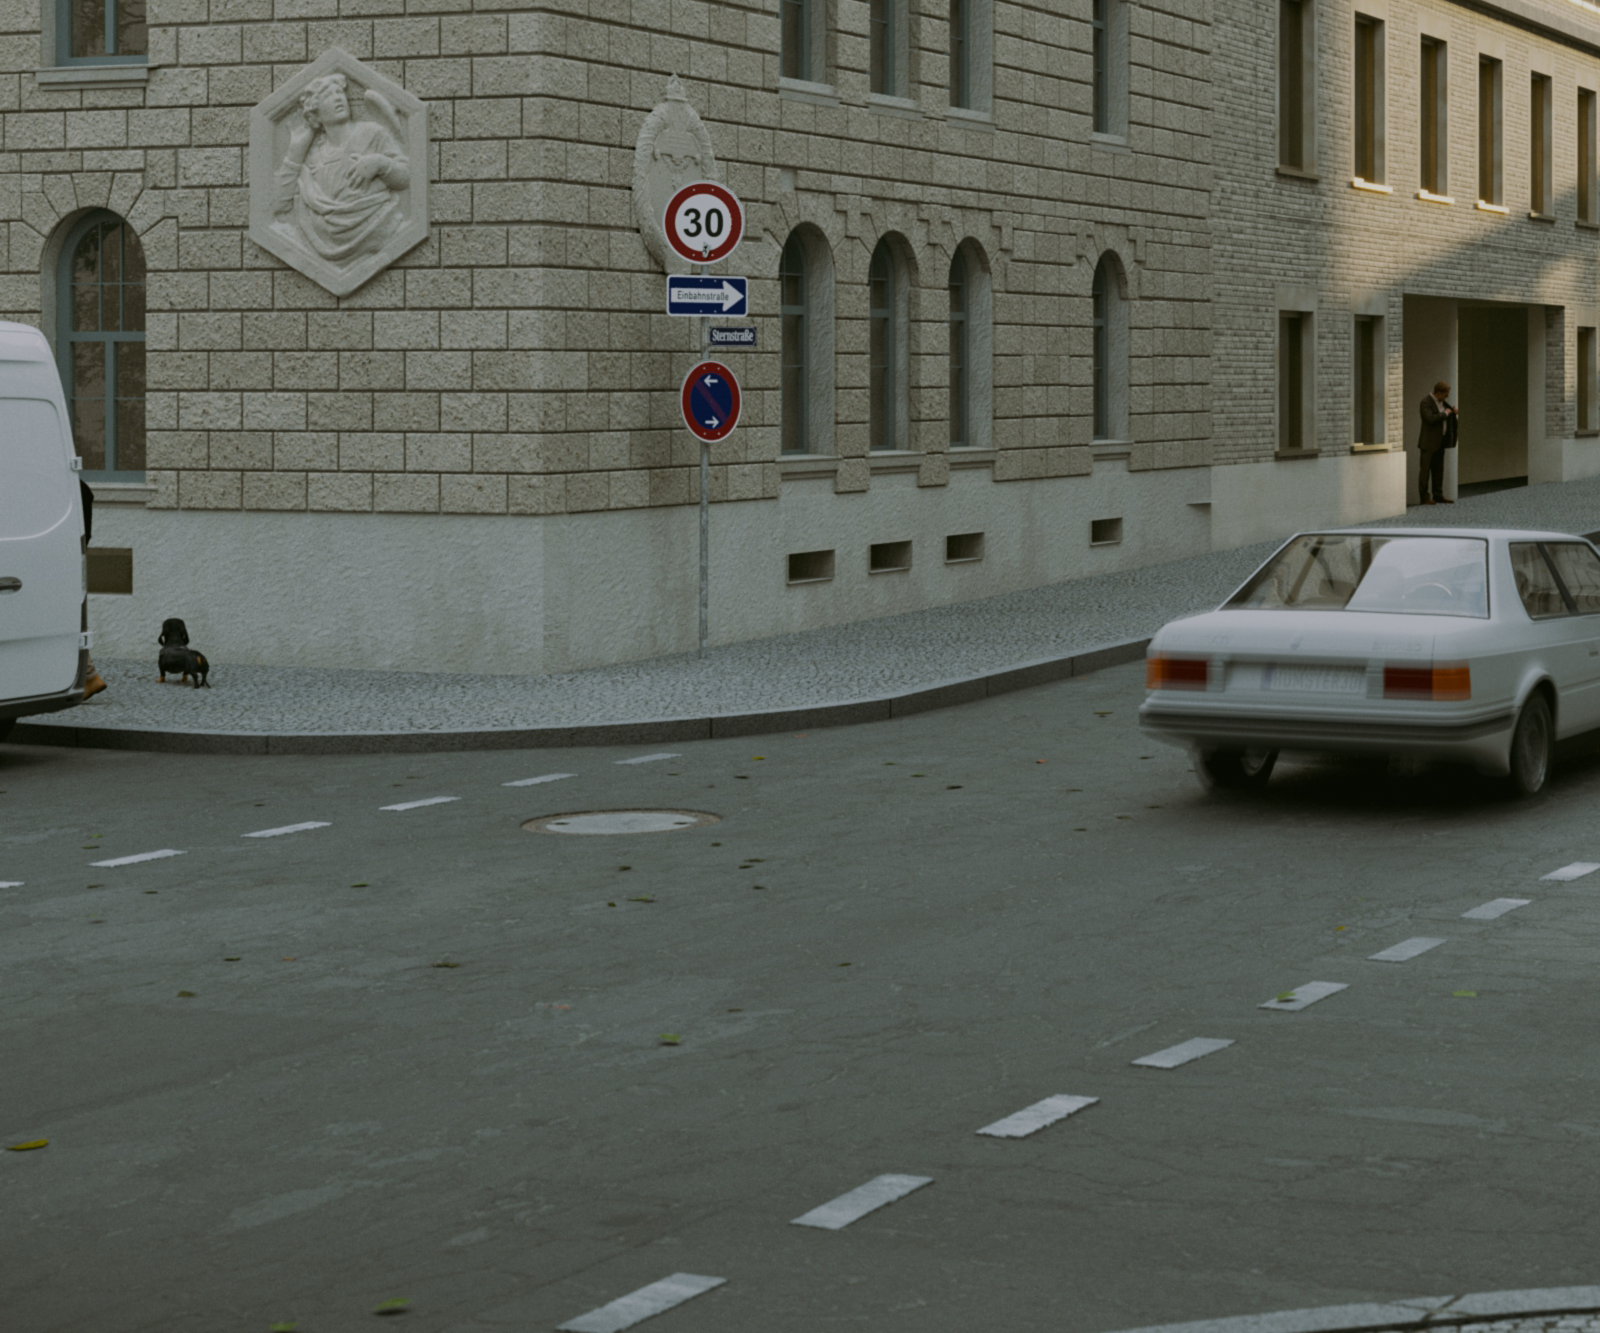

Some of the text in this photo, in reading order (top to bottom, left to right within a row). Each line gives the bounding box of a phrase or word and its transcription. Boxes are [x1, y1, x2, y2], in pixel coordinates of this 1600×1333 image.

[683, 208, 724, 237] 30
[677, 290, 730, 302] Einbahnstraße
[712, 328, 754, 342] Sternstraße
